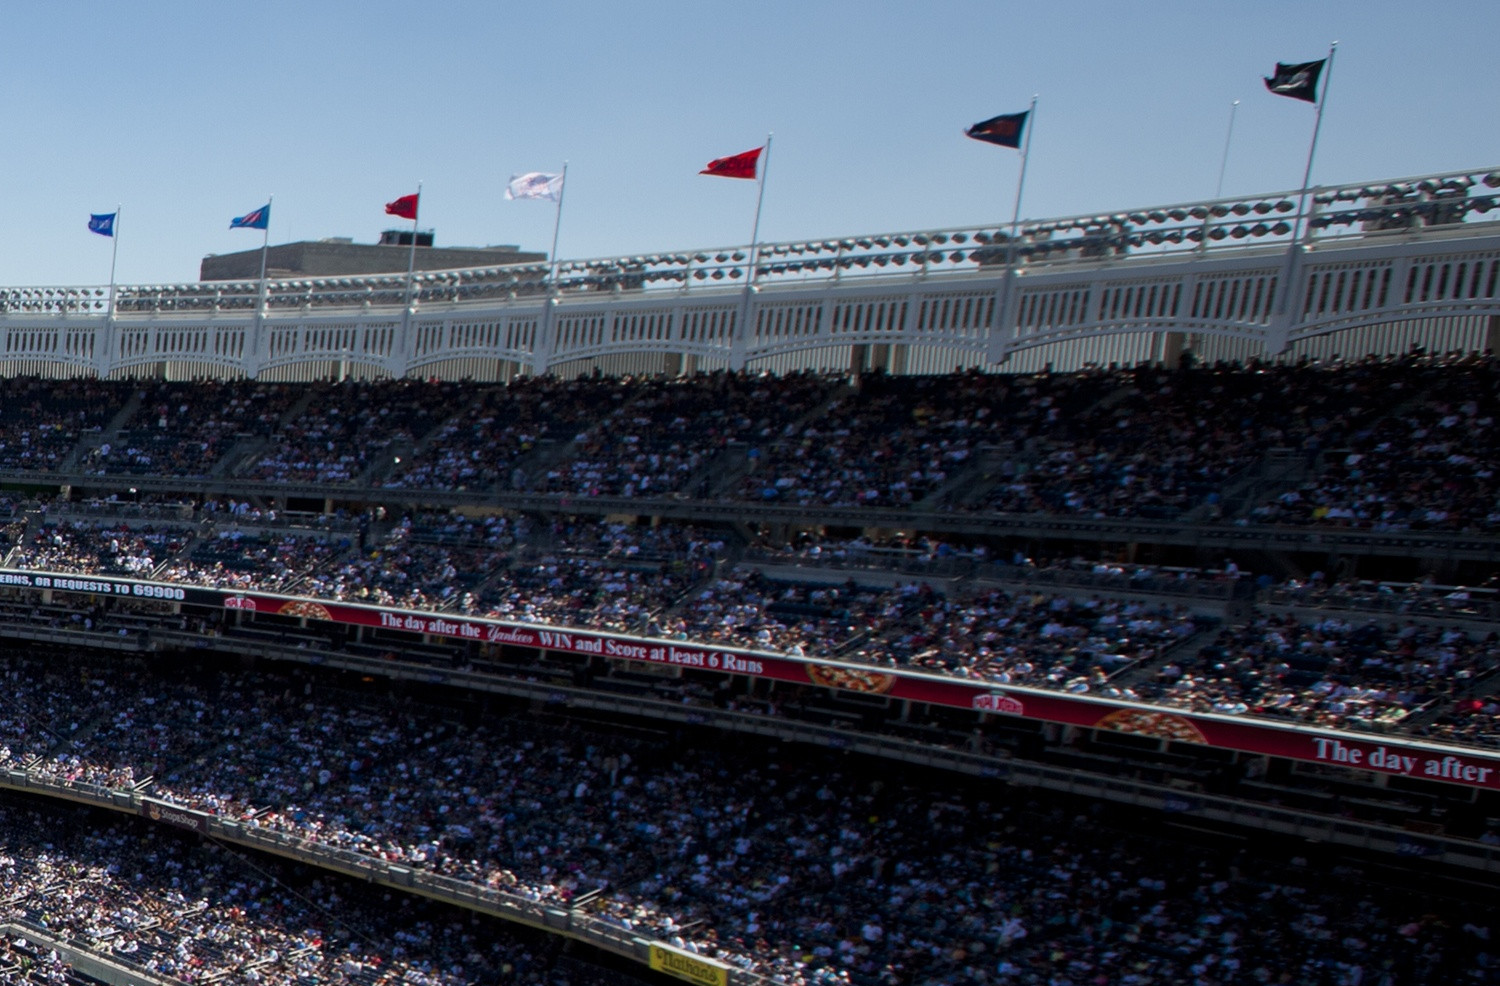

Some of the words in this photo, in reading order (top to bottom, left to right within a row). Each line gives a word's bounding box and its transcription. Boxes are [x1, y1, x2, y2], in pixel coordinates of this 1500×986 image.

[54, 578, 111, 593] REQUESTS
[114, 583, 130, 594] TO
[133, 584, 185, 600] 69900
[379, 612, 402, 627] The
[404, 616, 426, 632] day
[428, 620, 459, 635] after
[460, 622, 481, 638] the
[486, 624, 534, 645] Yankees
[538, 631, 573, 649] WIN
[575, 636, 602, 652] and
[605, 638, 647, 659] Score
[649, 647, 665, 661] at
[668, 648, 705, 666] least
[707, 652, 718, 667] 6
[722, 654, 763, 673] Runs
[1312, 737, 1363, 765] The
[1368, 746, 1419, 777] day
[1424, 755, 1494, 784] after
